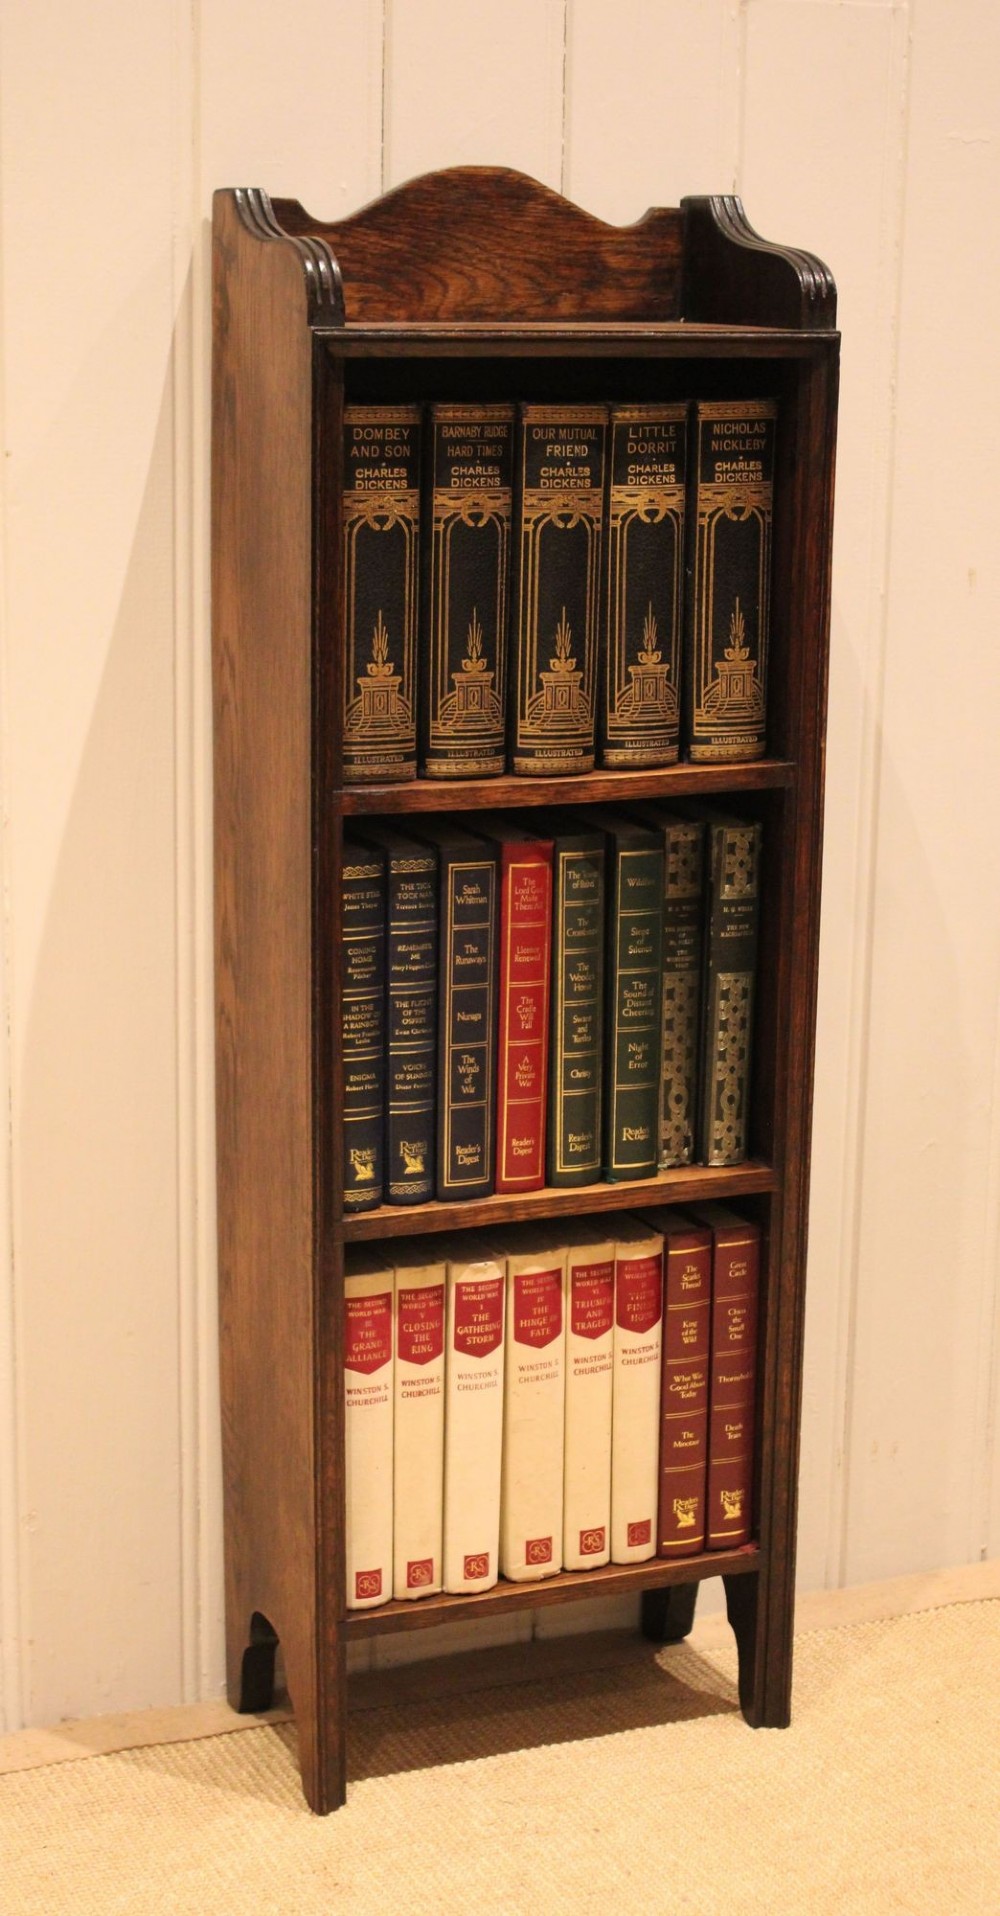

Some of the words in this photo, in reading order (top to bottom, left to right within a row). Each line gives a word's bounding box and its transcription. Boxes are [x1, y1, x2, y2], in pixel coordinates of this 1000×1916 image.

[442, 426, 481, 438] BARNABY
[483, 426, 508, 438] RUDGE
[629, 425, 676, 438] LITTLE
[713, 422, 766, 435] NICHOLAS
[352, 428, 410, 441] DOMBEY
[532, 428, 554, 440] OUR
[558, 428, 597, 440] MUTUAL
[627, 441, 677, 454] DORRIT
[711, 439, 767, 452] NICKLEBY
[350, 446, 381, 458] AND
[385, 446, 411, 457] SON
[447, 446, 473, 457] HARD
[477, 445, 503, 457] TIMES
[546, 445, 588, 457] FRIEND
[450, 466, 500, 475] CHARLES
[627, 464, 675, 473] CHARLES
[715, 461, 762, 472] CHARLES
[355, 468, 407, 478] CHARLES
[540, 467, 591, 477] CHARLES
[450, 477, 501, 488] DICKENS
[627, 474, 676, 485] DICKENS
[715, 472, 763, 483] DICKENS
[355, 479, 407, 490] DICKENS
[540, 478, 591, 489] DICKENS
[624, 739, 669, 748] ILLUSTRATED
[711, 736, 758, 745] ILLUSTRATED
[447, 748, 496, 758] ILLUSTRATED
[534, 748, 583, 758] ILLUSTRATED
[354, 754, 404, 764] ILLUSTRATED
[522, 877, 536, 886] The
[462, 883, 481, 894] Sarah
[464, 944, 479, 954] The
[576, 962, 589, 971] The
[632, 981, 647, 990] The
[623, 990, 646, 998] Sound
[520, 996, 534, 1005] The
[519, 1013, 533, 1022] Will
[521, 1021, 533, 1029] Fall
[461, 1055, 476, 1064] The
[523, 1055, 529, 1064] A
[635, 1052, 642, 1060] of
[457, 1063, 480, 1074] Winds
[518, 1063, 533, 1072] Very
[628, 1060, 648, 1069] Error
[349, 1073, 376, 1082] ENIGMA
[464, 1074, 472, 1083] of
[518, 1080, 532, 1088] War
[461, 1085, 476, 1094] War
[455, 1144, 481, 1155] Reader's
[512, 1146, 533, 1156] Digest
[457, 1155, 480, 1166] Digest
[575, 1271, 587, 1279] THE
[521, 1279, 534, 1287] THE
[575, 1280, 599, 1288] WORLD
[461, 1285, 475, 1293] THE
[522, 1287, 545, 1295] WORLD
[401, 1293, 415, 1301] THE
[462, 1293, 485, 1301] WORLD
[575, 1297, 612, 1309] TRIUMPH
[348, 1310, 372, 1318] WORLD
[532, 1305, 549, 1315] THE
[586, 1310, 604, 1319] AND
[472, 1312, 490, 1322] THE
[403, 1320, 440, 1332] CLOSING
[457, 1320, 501, 1335] GATHERING
[520, 1317, 547, 1328] HINGE
[575, 1318, 610, 1331] TRAGEDY
[359, 1330, 377, 1340] THE
[530, 1327, 552, 1338] FATE
[413, 1333, 430, 1343] THE
[466, 1334, 494, 1345] STORM
[352, 1340, 383, 1352] GRAND
[411, 1343, 433, 1354] RING
[621, 1344, 653, 1355] WINSTON
[346, 1350, 387, 1362] ALLIANCE
[574, 1353, 606, 1365] WINSTON
[621, 1353, 659, 1366] CHURCHILL
[518, 1360, 553, 1372] WINSTON
[573, 1363, 613, 1376] CHURCHILL
[457, 1371, 492, 1381] WINSTON
[518, 1370, 559, 1384] CHURCHILL
[401, 1377, 434, 1387] WINSTON
[457, 1380, 498, 1392] CHURCHILL
[346, 1385, 381, 1395] WINSTON
[401, 1386, 440, 1398] CHURCHILL
[669, 1383, 689, 1392] Good
[346, 1395, 388, 1407] CHURCHILL
[682, 1431, 694, 1440] The
